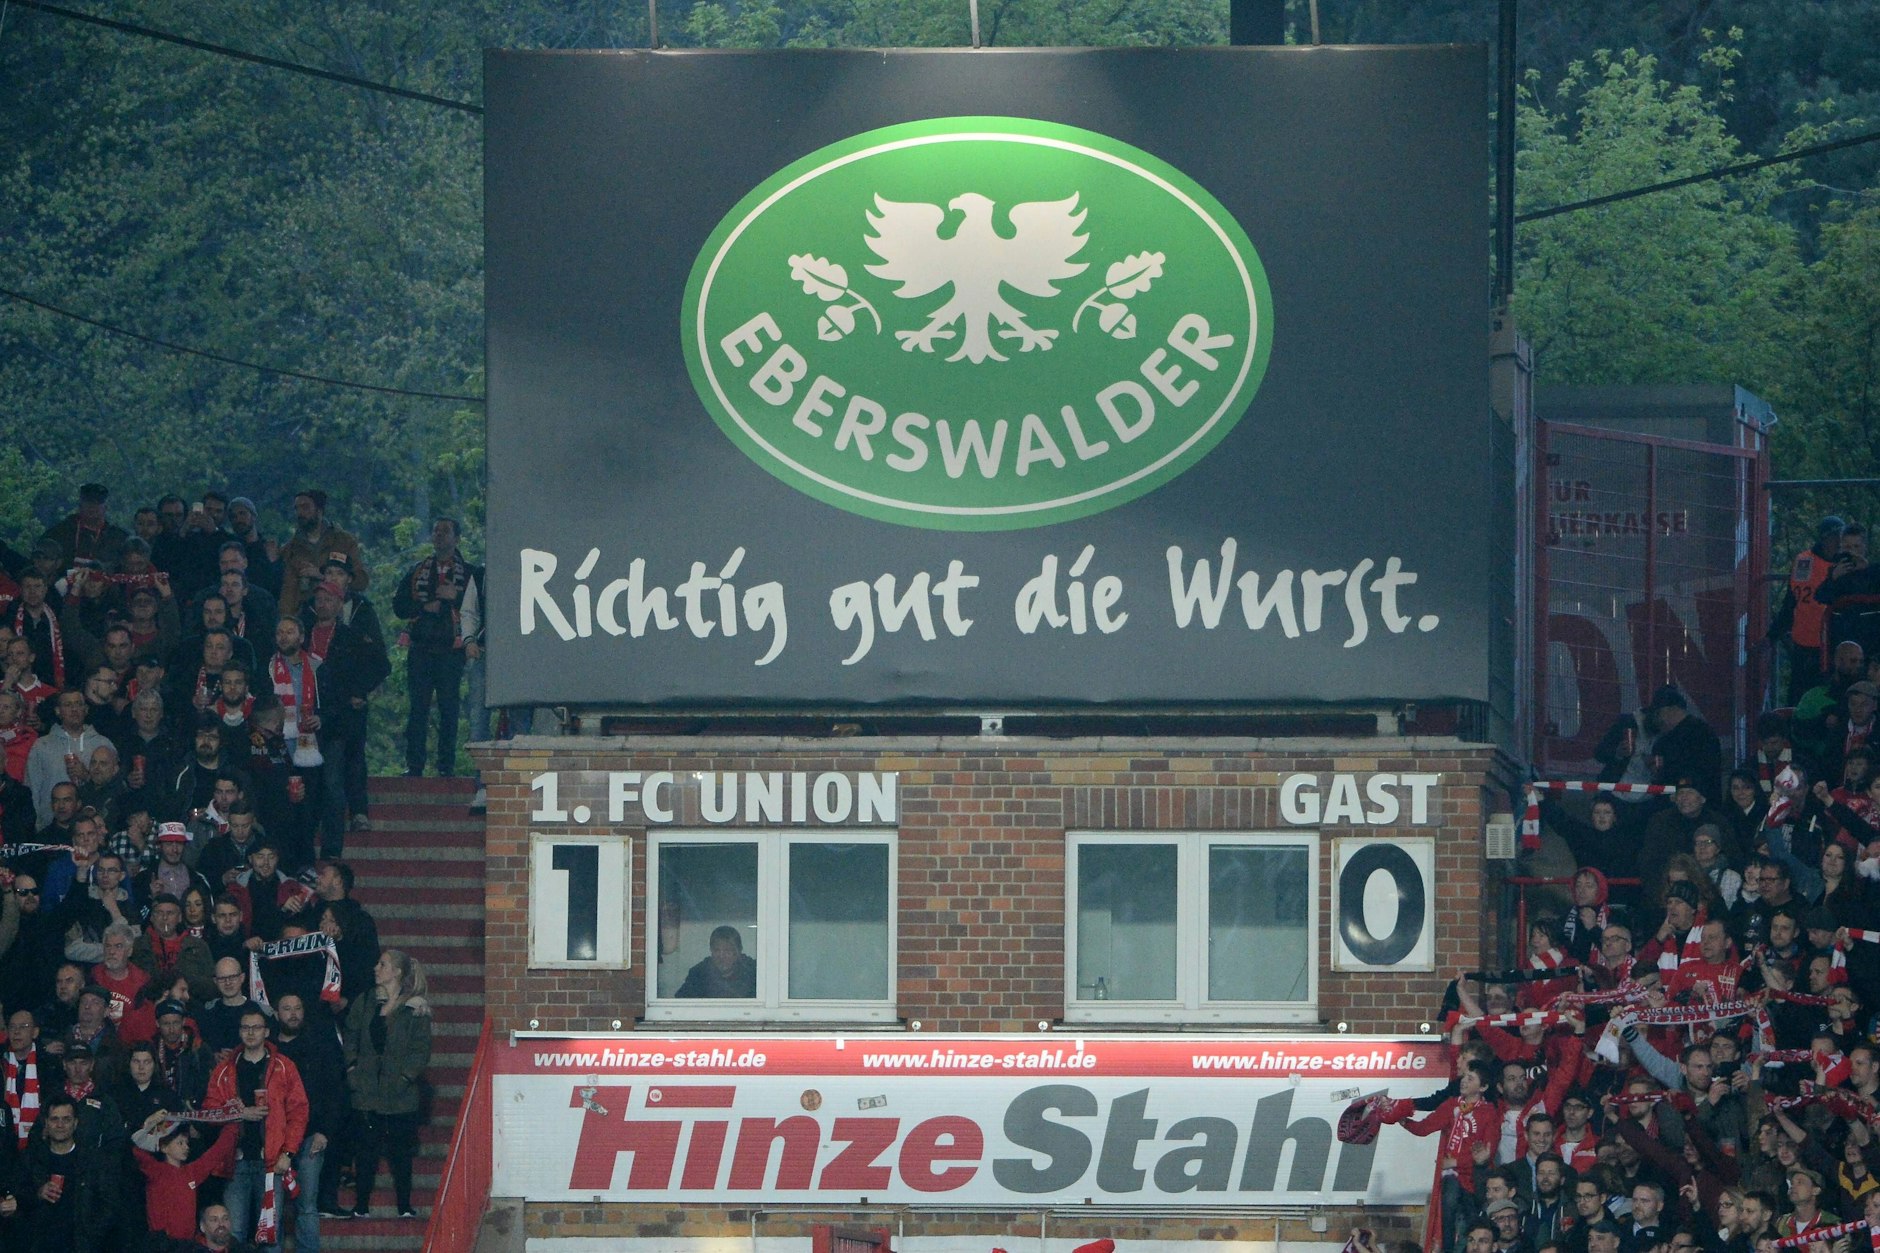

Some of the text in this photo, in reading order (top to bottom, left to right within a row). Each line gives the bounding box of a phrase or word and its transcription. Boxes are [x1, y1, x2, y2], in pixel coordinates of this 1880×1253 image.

[720, 312, 1234, 479] EBERSWALDER
[521, 547, 788, 666] Richtig
[829, 560, 980, 666] gut
[1015, 545, 1129, 635] die
[1166, 537, 1440, 648] Wurst.
[531, 772, 896, 823] 1. FC UNION
[1279, 773, 1438, 824] GAST
[552, 845, 599, 960] 1
[1339, 843, 1425, 966] 0
[262, 932, 331, 957] ERLIN
[534, 1049, 767, 1068] www.hinze-stahl.de
[862, 1049, 1097, 1069] www.hinze-stahl.de
[1191, 1051, 1427, 1070] www.hinze-stahl.de
